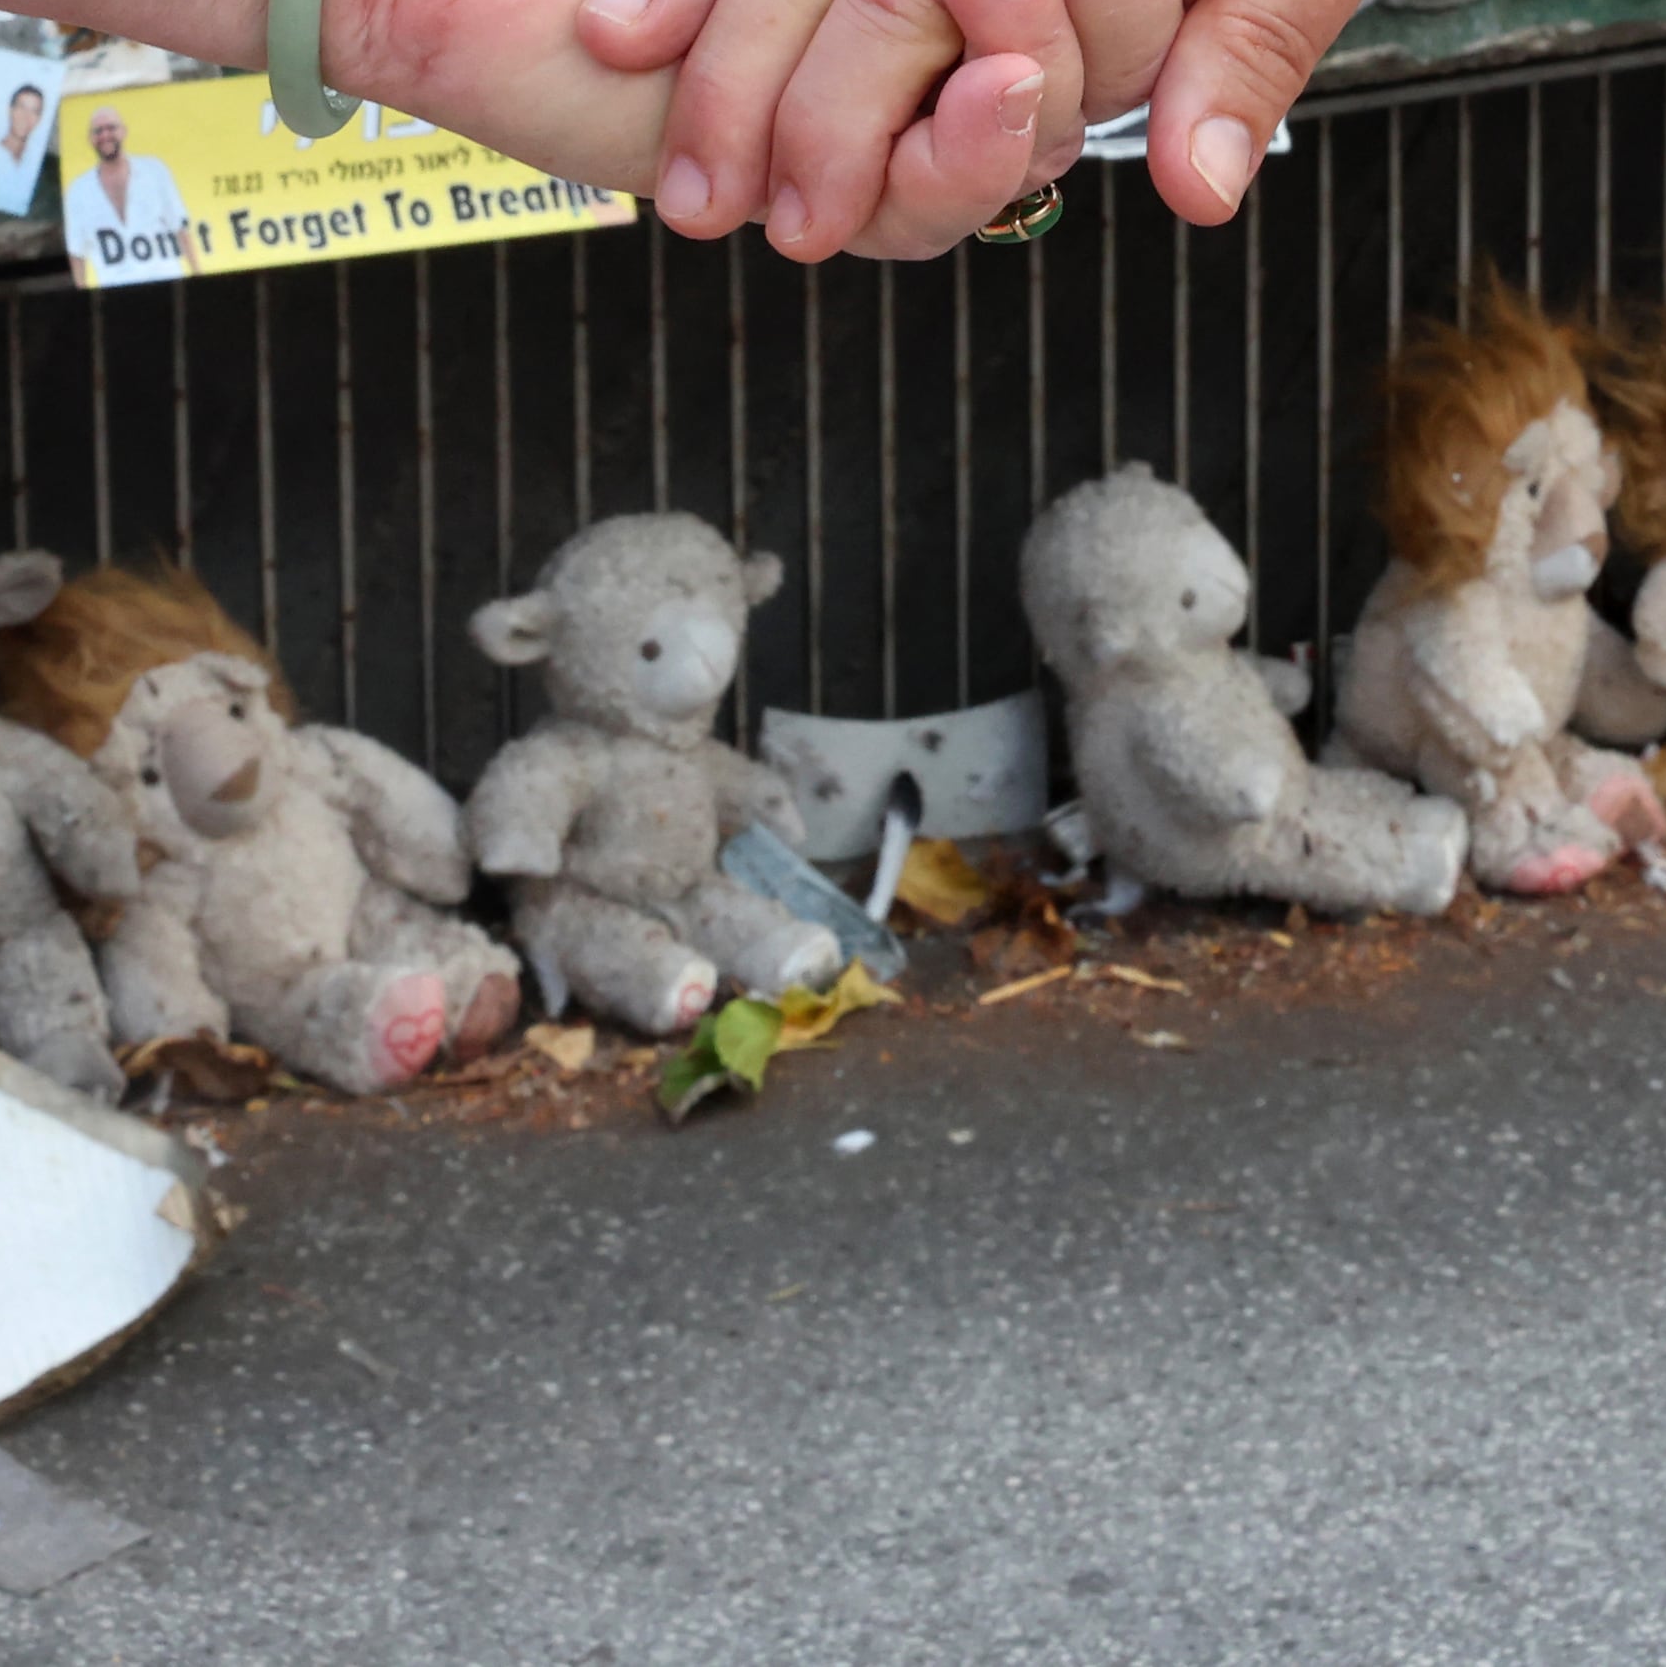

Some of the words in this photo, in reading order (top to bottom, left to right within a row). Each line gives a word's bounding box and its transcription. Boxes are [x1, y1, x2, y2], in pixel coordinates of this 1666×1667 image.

[414, 145, 471, 175] ליאור
[95, 214, 213, 267] Don't
[230, 202, 368, 252] Forget
[384, 189, 431, 231] To
[448, 176, 616, 226] Breathe
